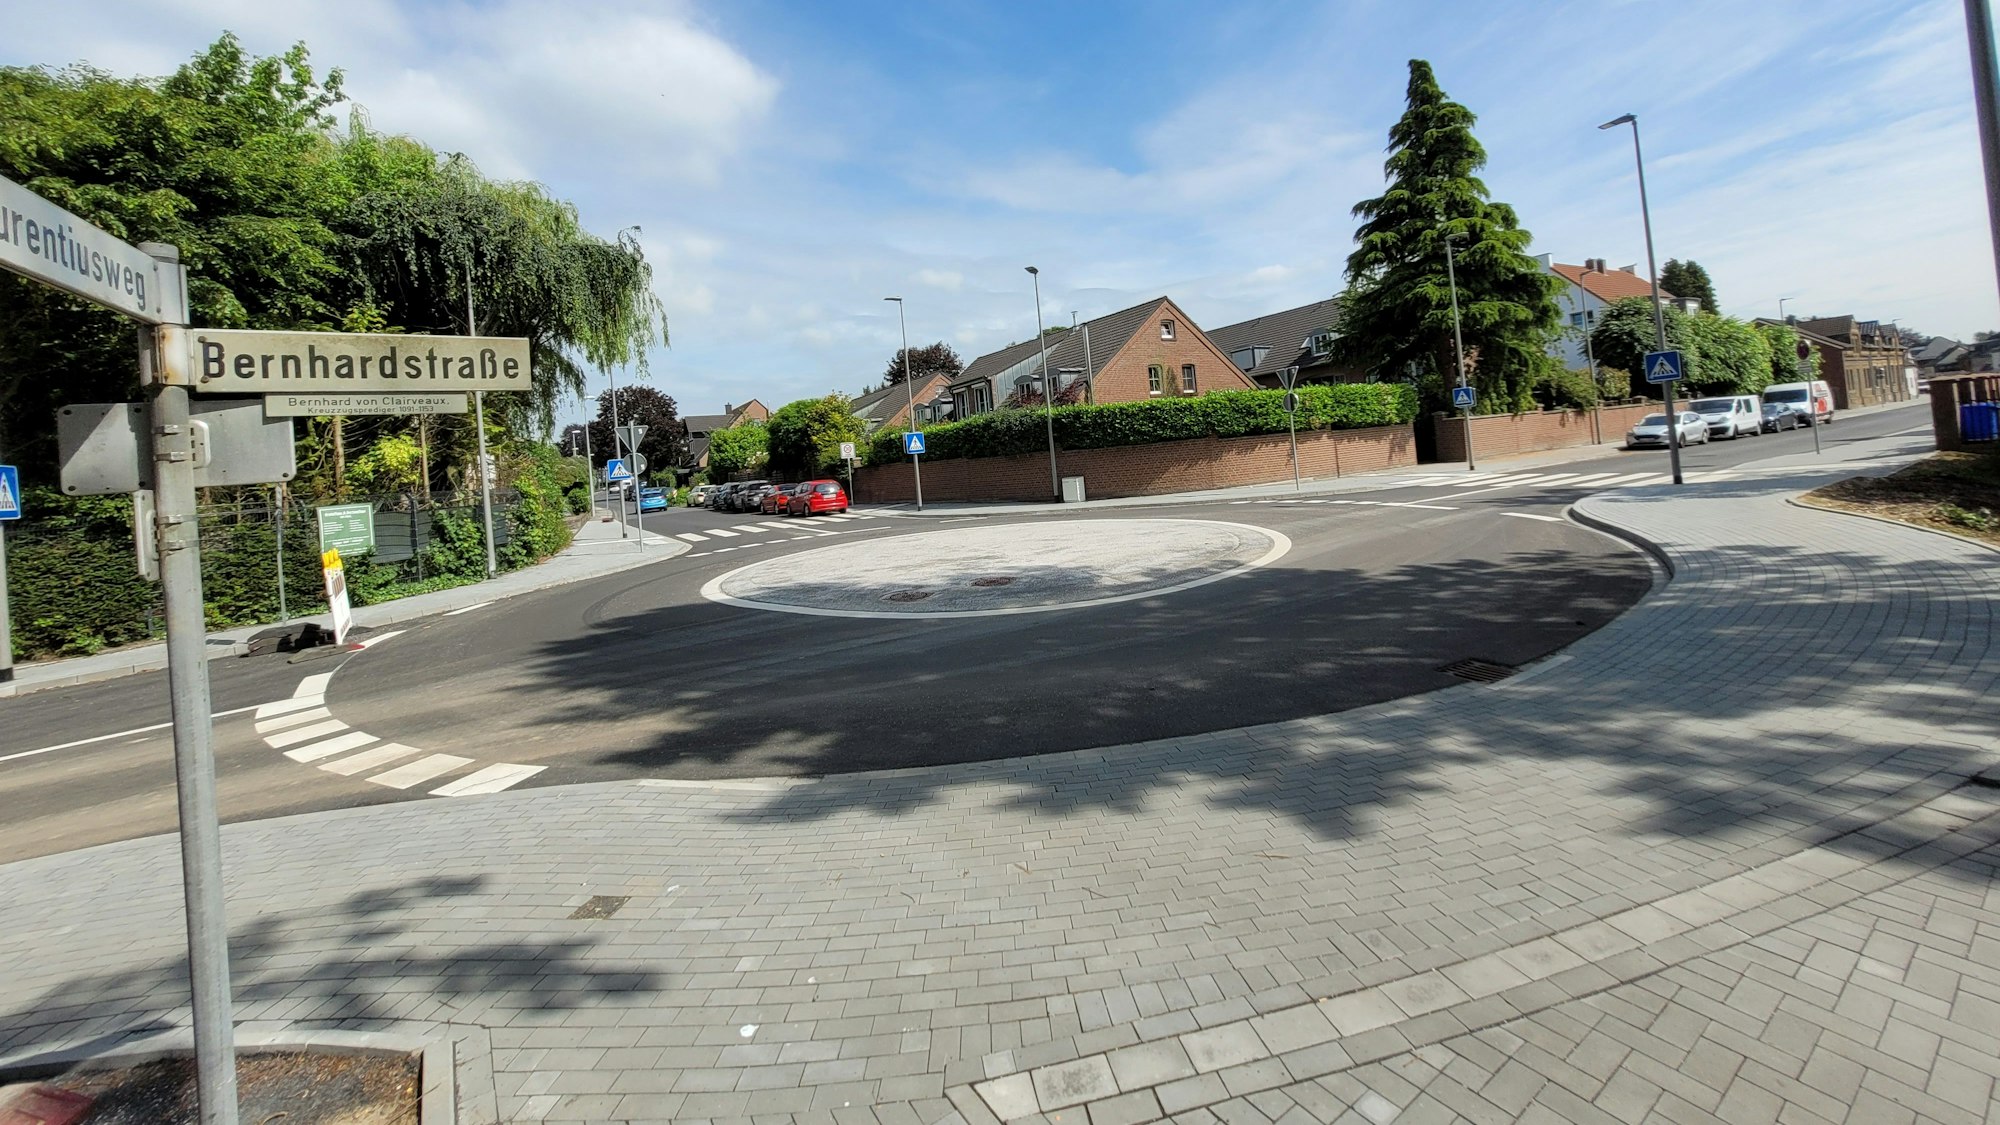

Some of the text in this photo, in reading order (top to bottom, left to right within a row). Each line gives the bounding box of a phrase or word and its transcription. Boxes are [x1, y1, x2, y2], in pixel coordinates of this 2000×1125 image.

[202, 341, 520, 380] Bernhardstraße
[288, 397, 351, 407] Bernhard
[356, 398, 378, 406] von
[307, 405, 434, 415] Kreuzzugsprediger 1091-1153
